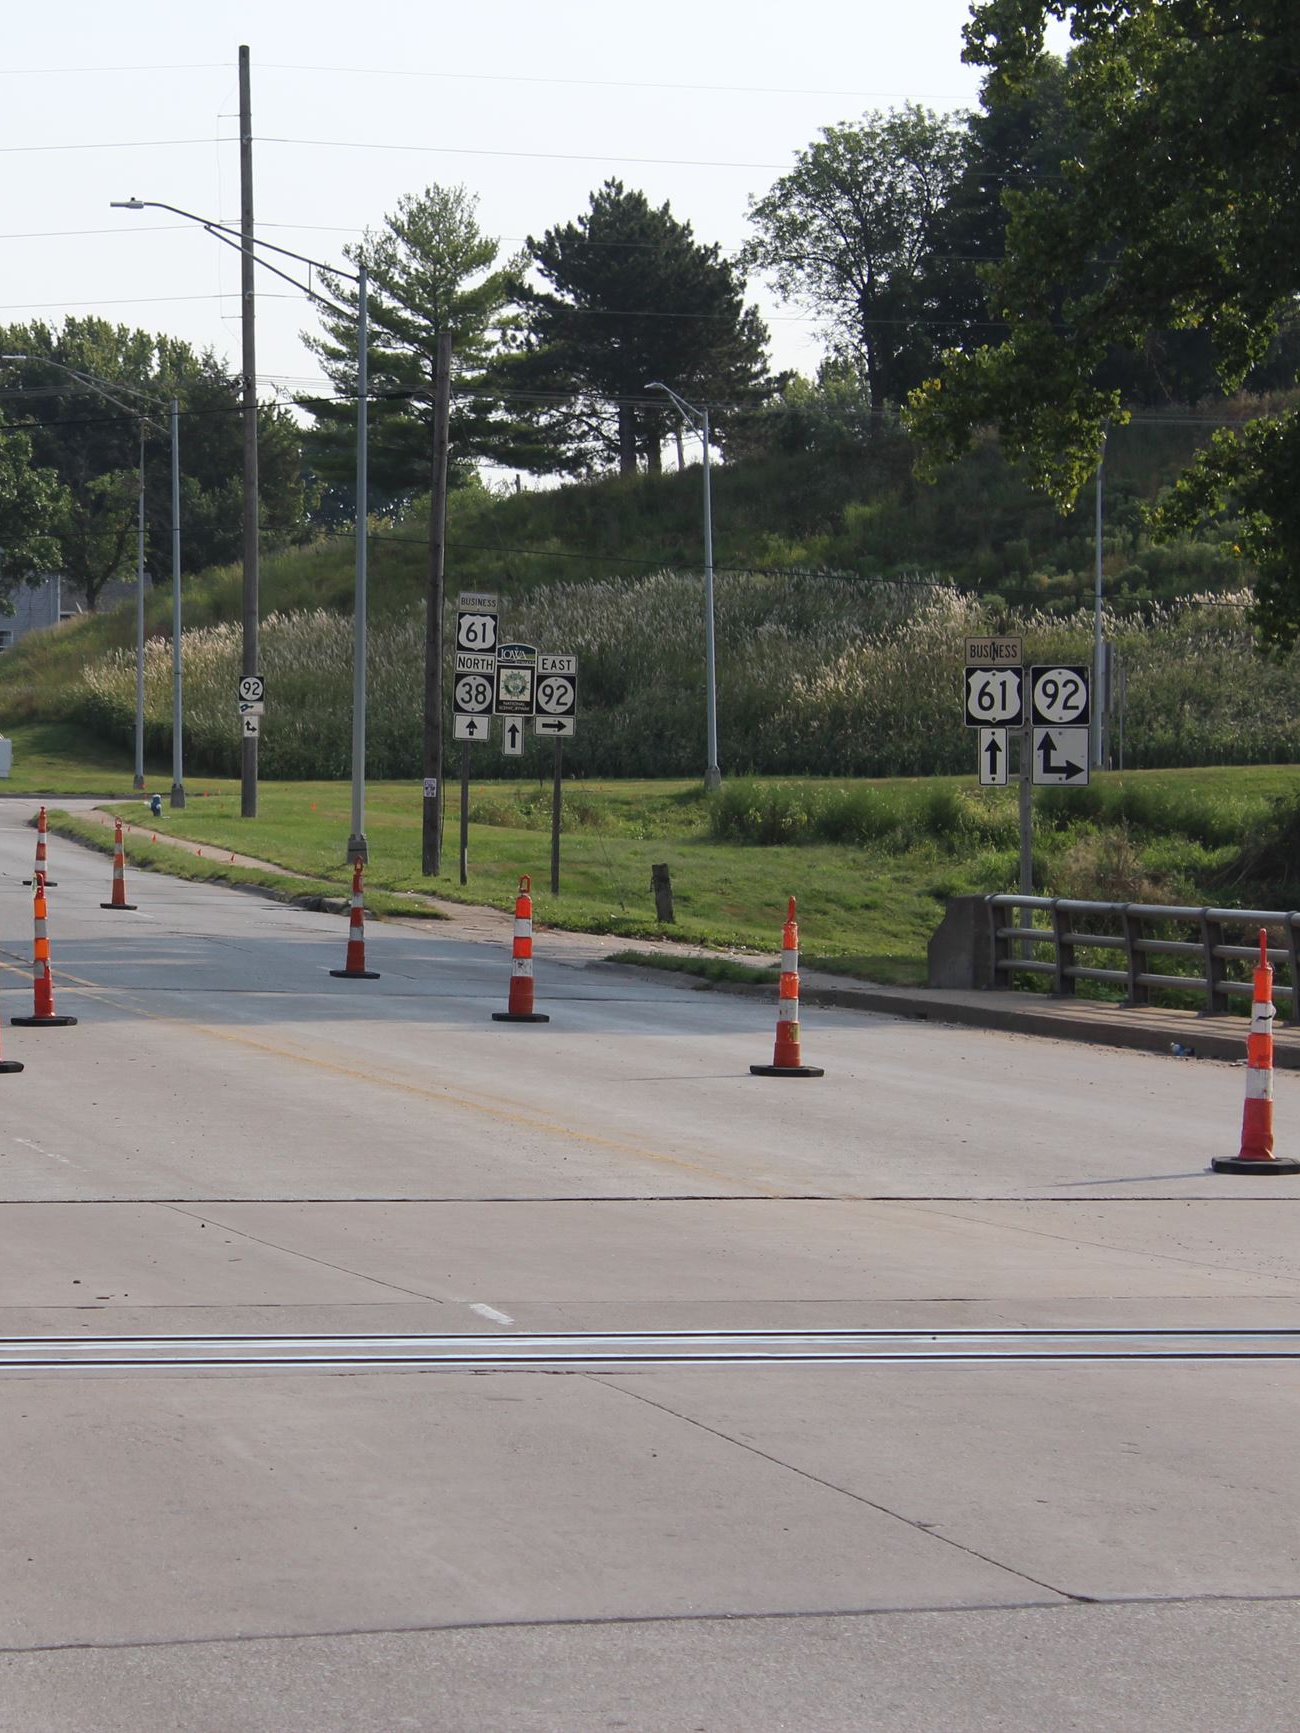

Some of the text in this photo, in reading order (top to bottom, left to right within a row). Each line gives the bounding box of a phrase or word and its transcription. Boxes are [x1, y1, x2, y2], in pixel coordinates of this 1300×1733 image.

[461, 597, 497, 608] BUSINESS
[466, 622, 487, 643] 61
[970, 644, 1018, 658] BUSINESS
[457, 656, 494, 671] NORTH
[542, 658, 572, 671] EAST
[243, 681, 260, 696] 92
[460, 682, 487, 705] 38
[542, 684, 568, 706] 92
[977, 680, 1007, 711] 61
[1041, 679, 1080, 711] 92
